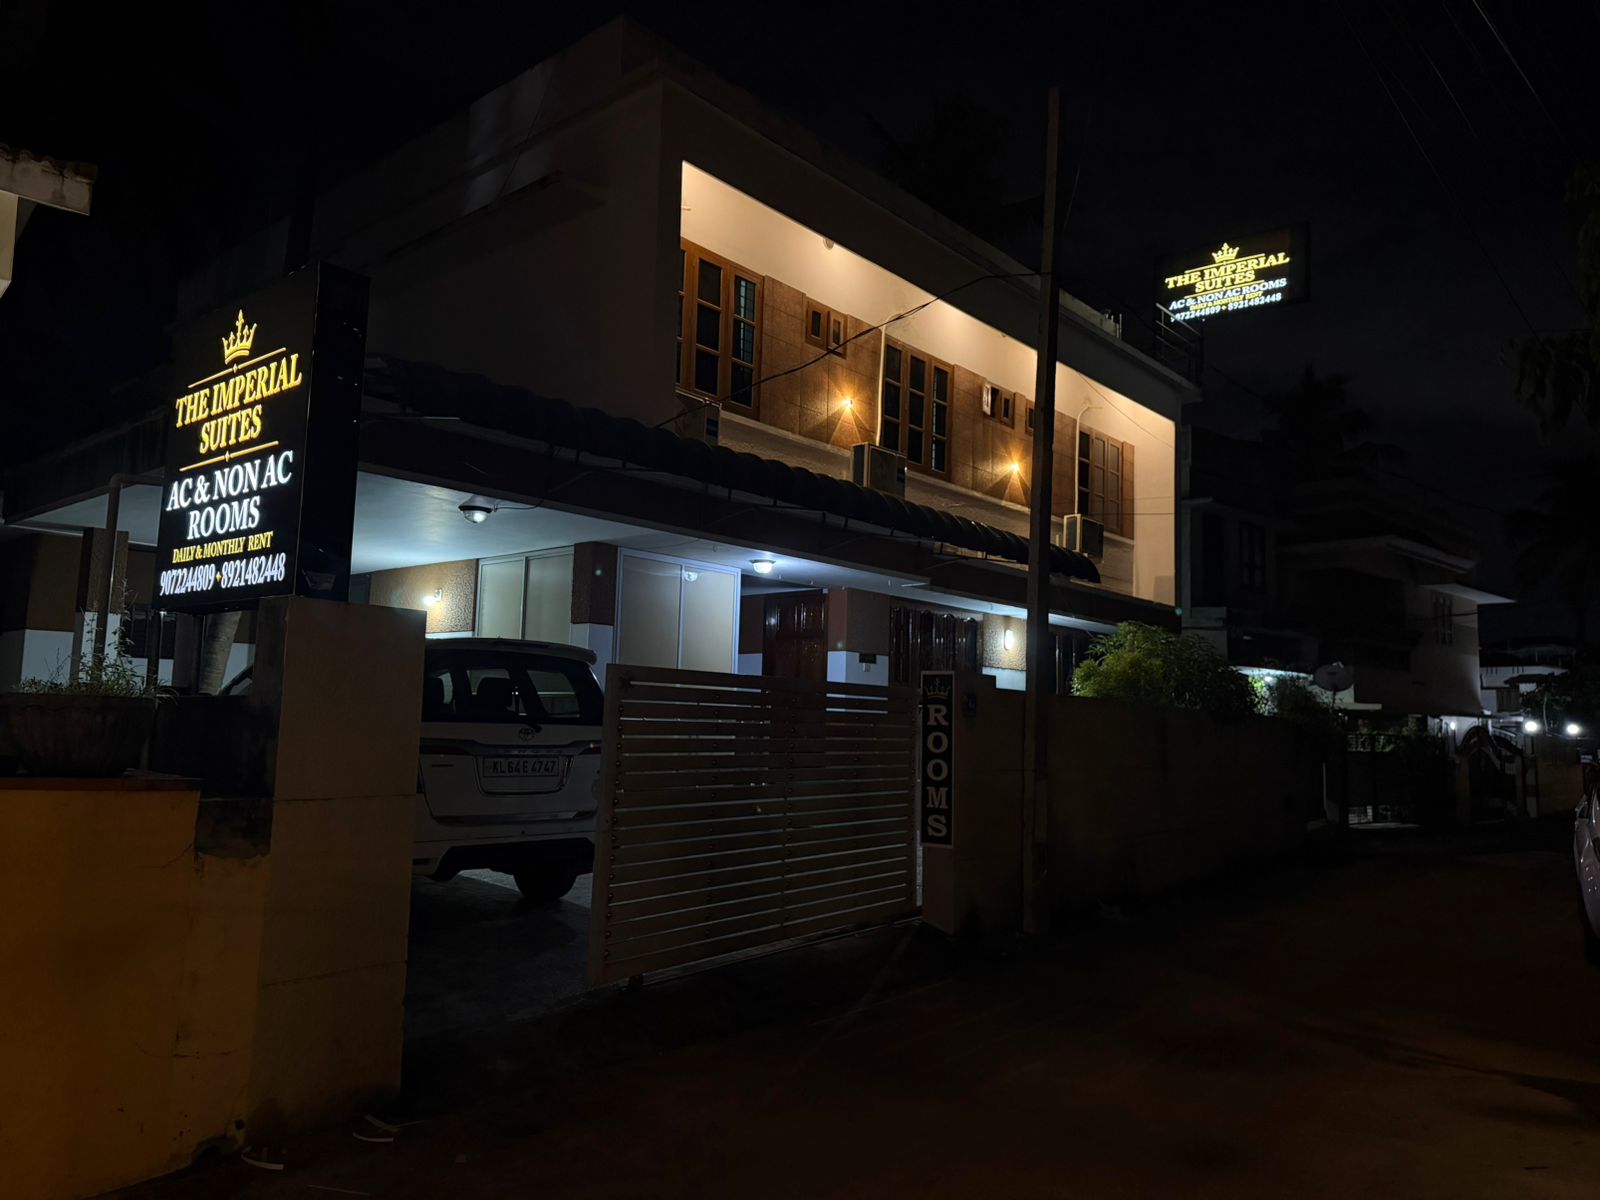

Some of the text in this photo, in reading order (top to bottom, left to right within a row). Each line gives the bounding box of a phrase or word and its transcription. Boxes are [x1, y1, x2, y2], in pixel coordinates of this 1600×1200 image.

[1165, 252, 1290, 289] THE IMPERIAL
[1195, 270, 1255, 293] SUITES
[1169, 299, 1186, 311] AC
[1196, 291, 1224, 304] NON
[1224, 287, 1241, 299] AC
[1242, 278, 1287, 295] ROOMS
[1227, 292, 1282, 311] 8921482448
[175, 353, 302, 428] THE IMPERIAL
[200, 404, 262, 454] SUITES
[166, 450, 293, 511] AC & NON AC
[187, 496, 260, 540] ROOMS
[203, 537, 246, 558] MONTHLY
[248, 530, 274, 552] RENT
[160, 552, 286, 596] 9072244809 8921482448
[926, 704, 950, 838] ROOMS
